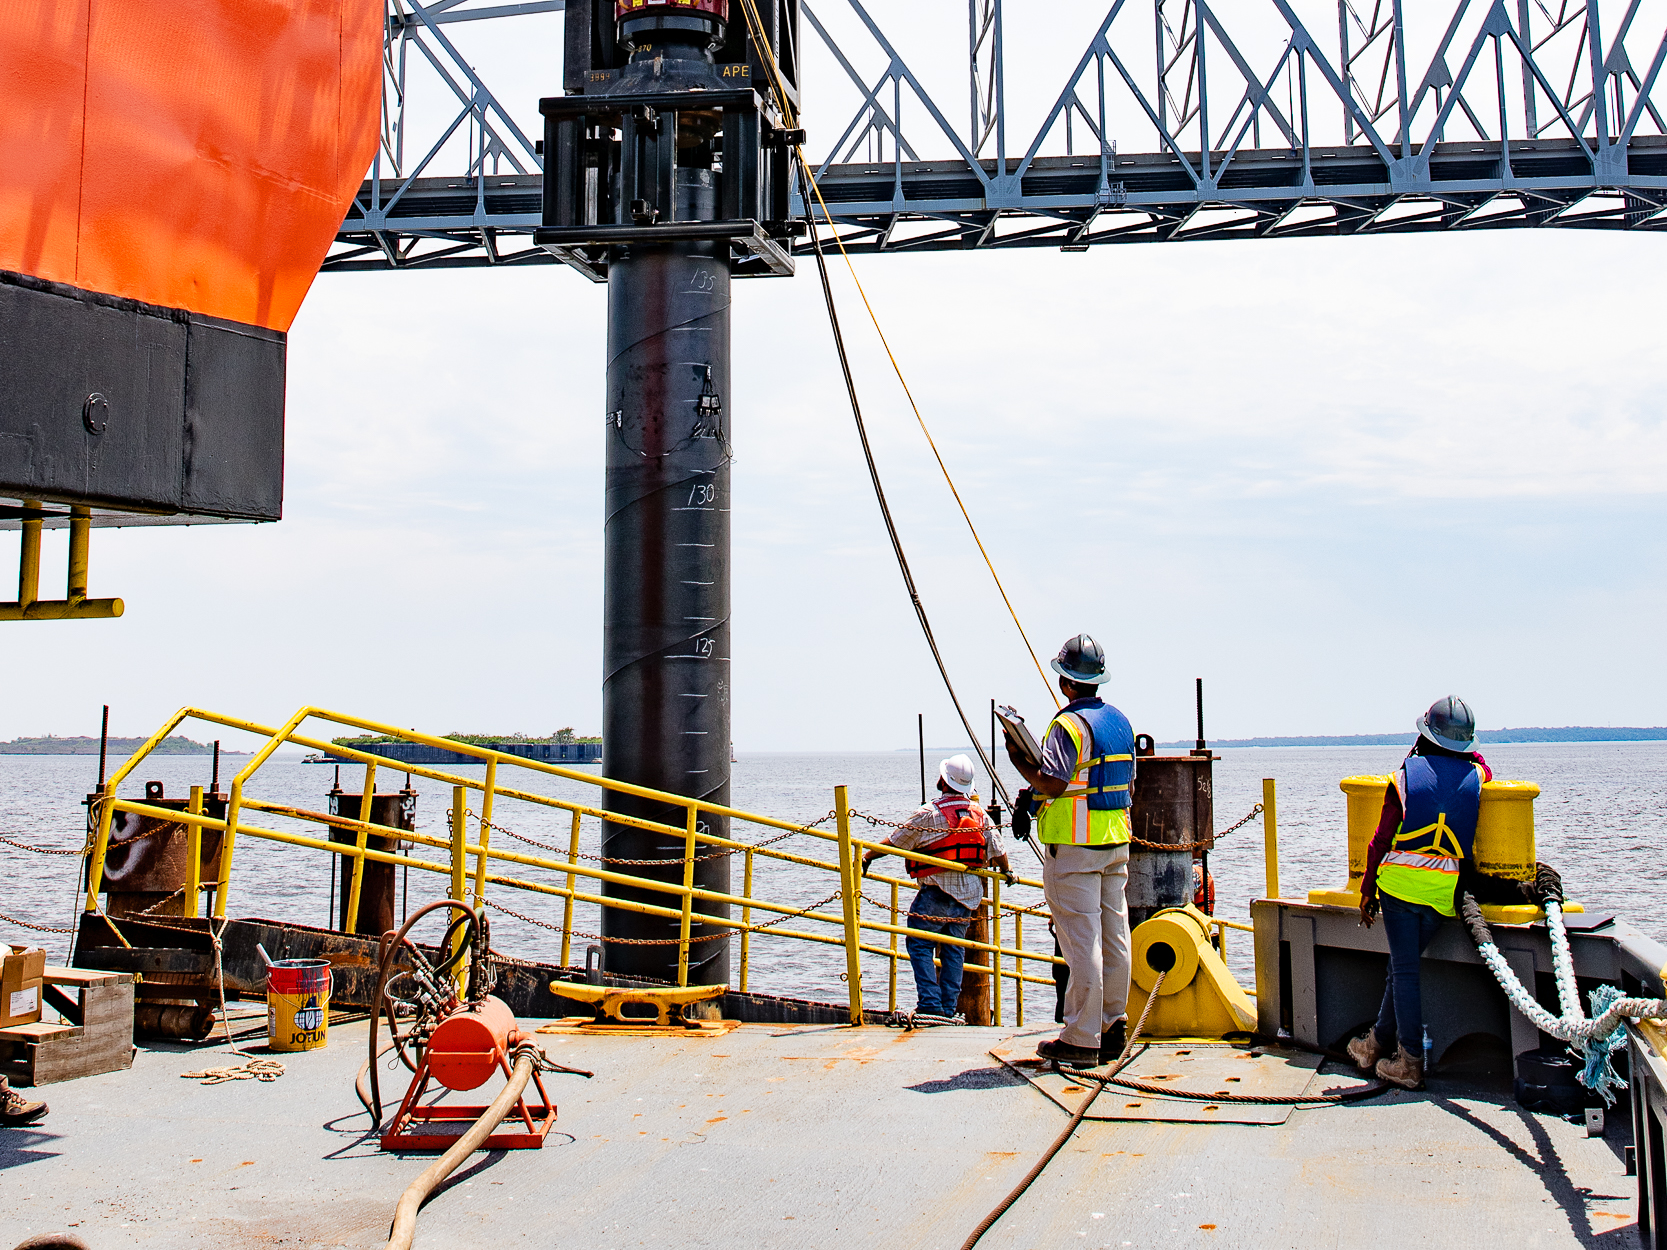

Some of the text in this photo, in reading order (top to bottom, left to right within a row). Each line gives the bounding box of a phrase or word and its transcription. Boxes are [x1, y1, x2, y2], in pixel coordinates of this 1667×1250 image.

[722, 65, 749, 77] APE
[690, 267, 717, 291] 135
[687, 483, 715, 506] 130
[695, 637, 716, 657] 125
[289, 1029, 326, 1045] JOTUN
